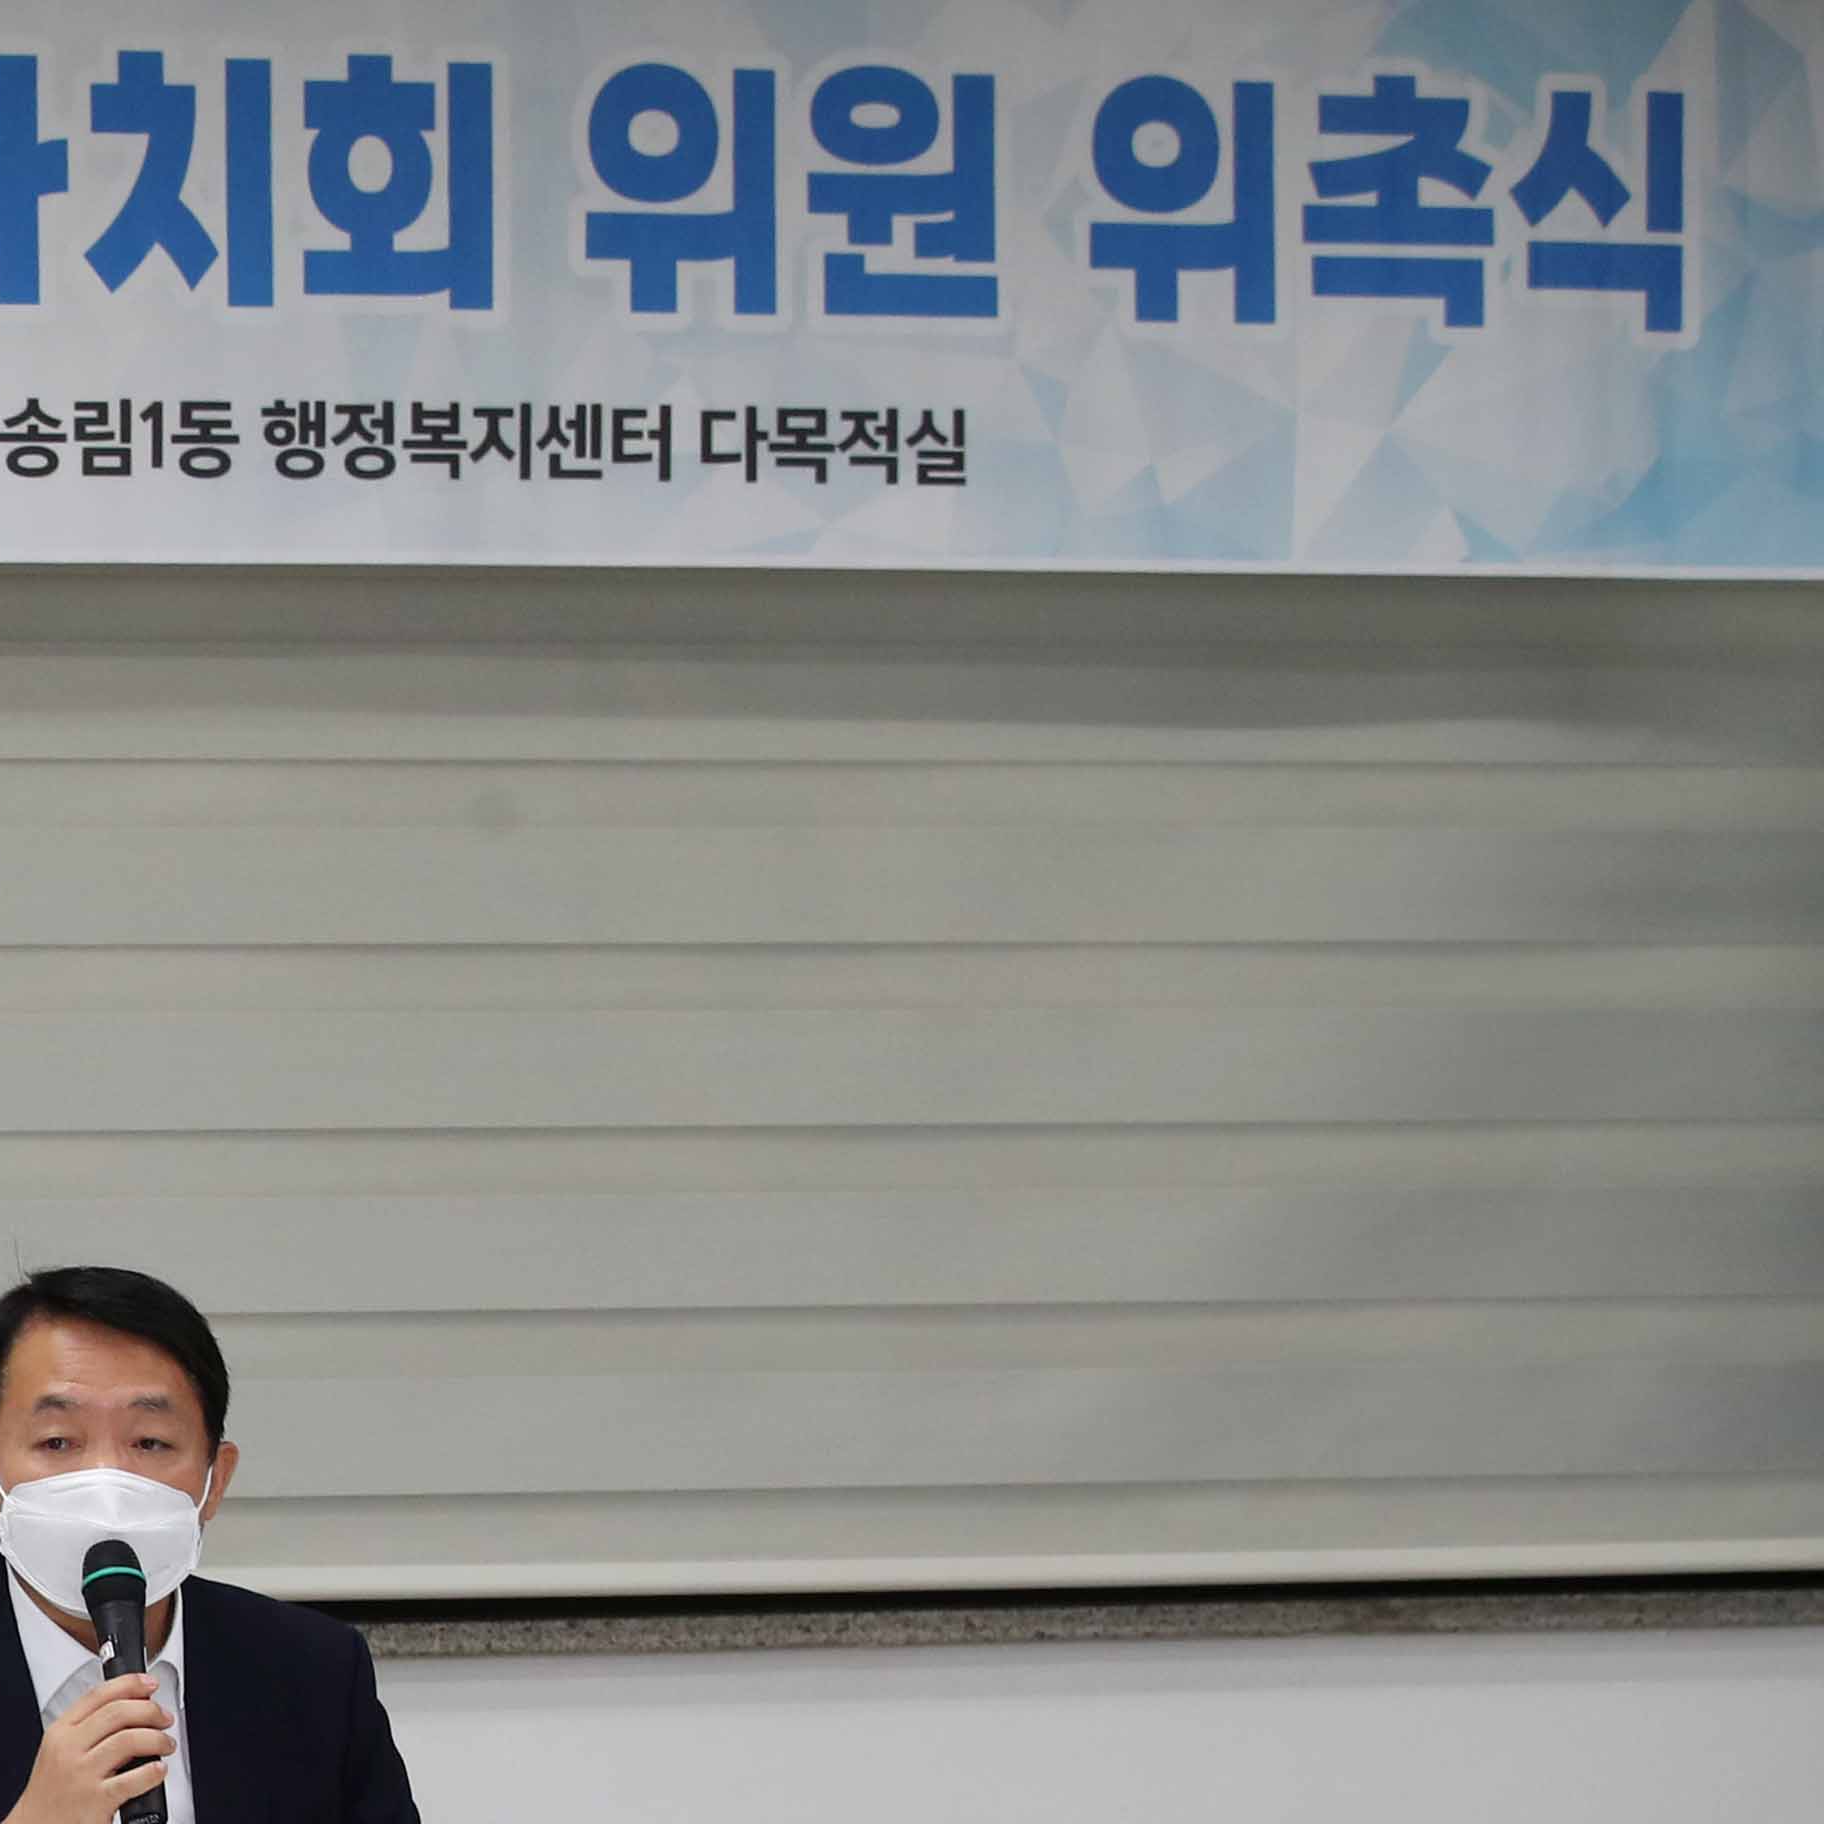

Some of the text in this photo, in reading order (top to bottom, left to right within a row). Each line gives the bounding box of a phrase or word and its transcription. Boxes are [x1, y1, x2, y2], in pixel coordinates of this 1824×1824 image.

[585, 62, 1000, 318] 위원
[1090, 74, 1685, 333] 위촉식
[260, 399, 674, 483] 행정복지센터
[699, 405, 969, 487] 다목적실
